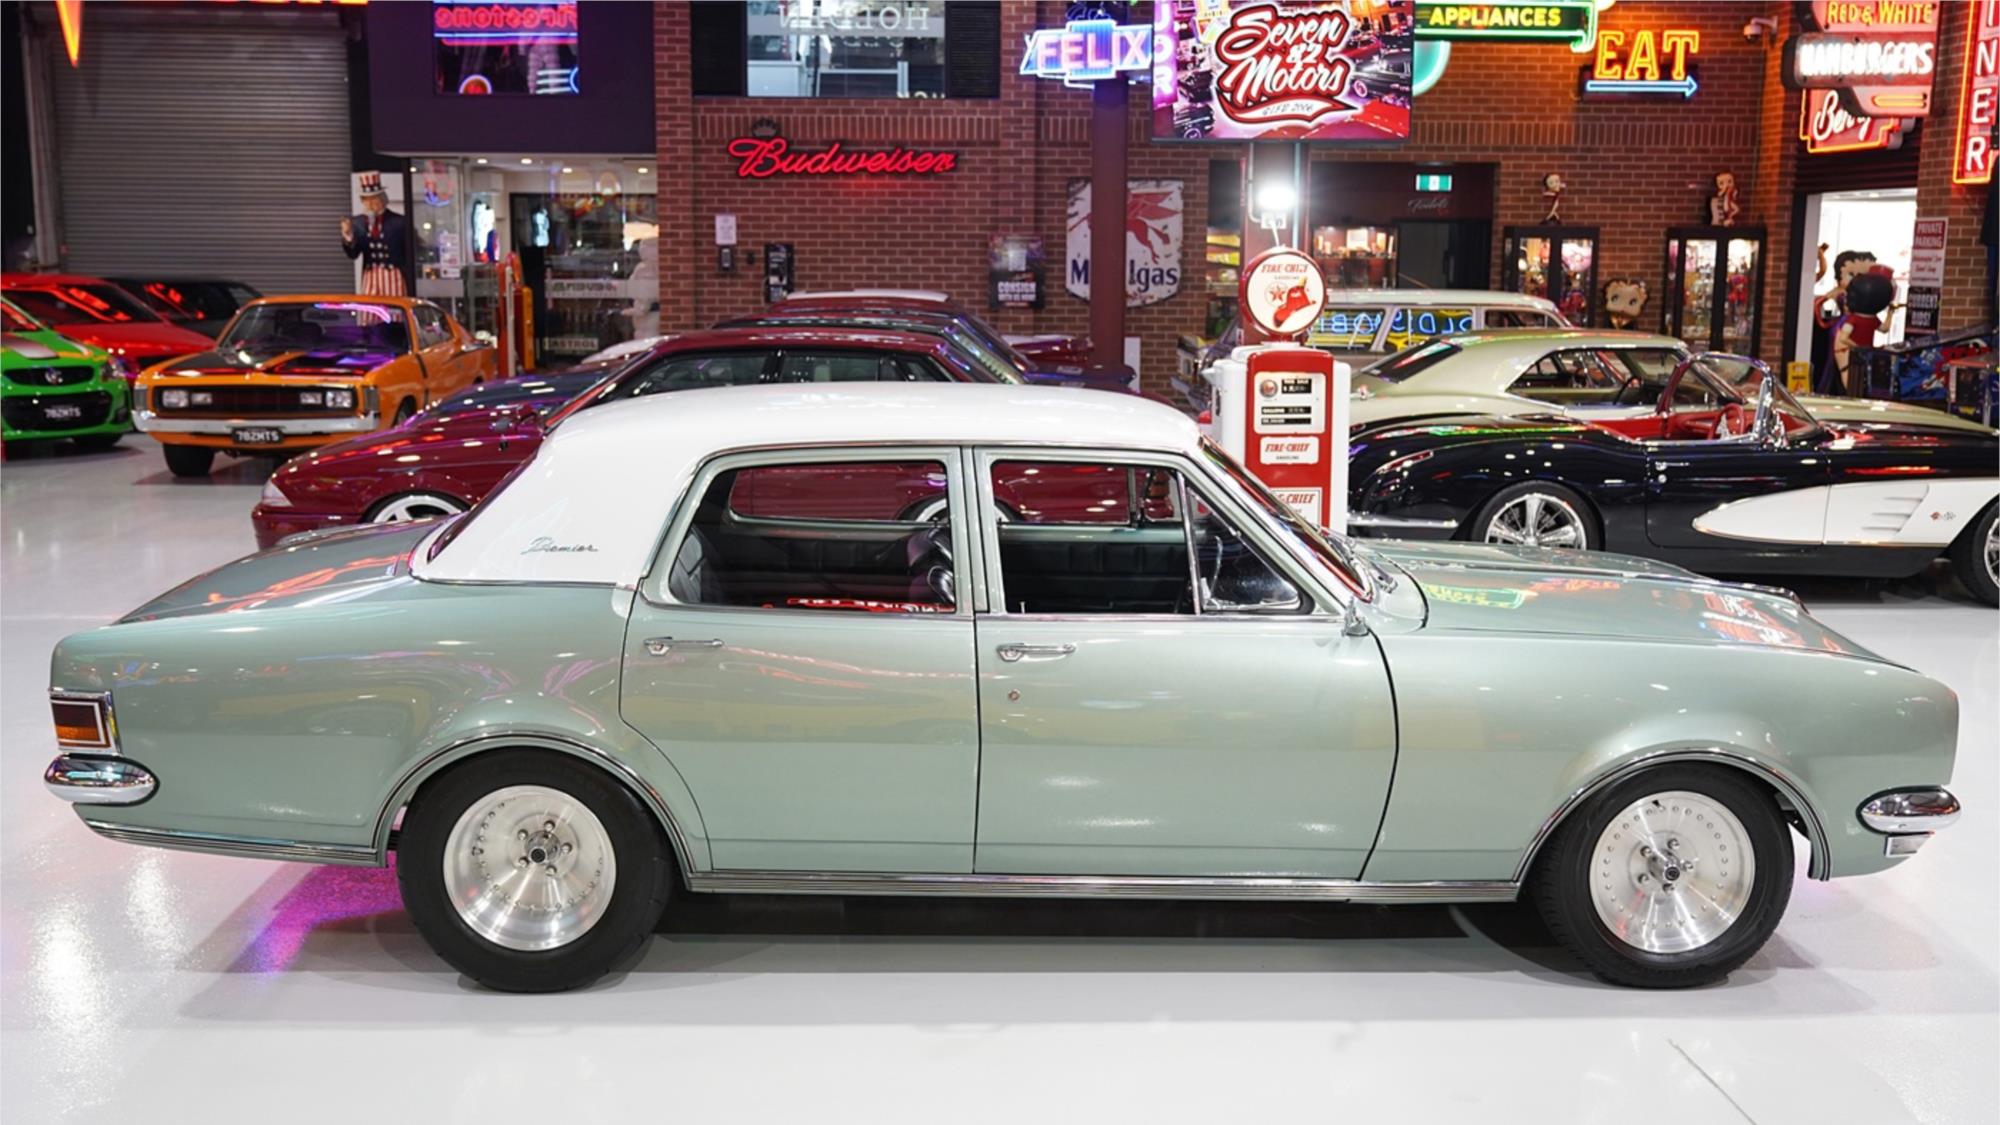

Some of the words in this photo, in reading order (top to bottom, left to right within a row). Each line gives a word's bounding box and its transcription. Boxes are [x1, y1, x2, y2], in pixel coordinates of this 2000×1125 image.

[1429, 7, 1561, 27] APPLIANCES
[1828, 2, 1857, 23] RED
[1878, 2, 1934, 24] WHITE
[1037, 31, 1147, 72] FELIX
[1221, 10, 1341, 61] Seven
[1594, 30, 1700, 80] EAT
[1800, 40, 1934, 76] HAMBURGERS
[1223, 54, 1345, 105] Motors
[728, 138, 957, 177] Budweiser
[1070, 258, 1179, 293] Mlgas
